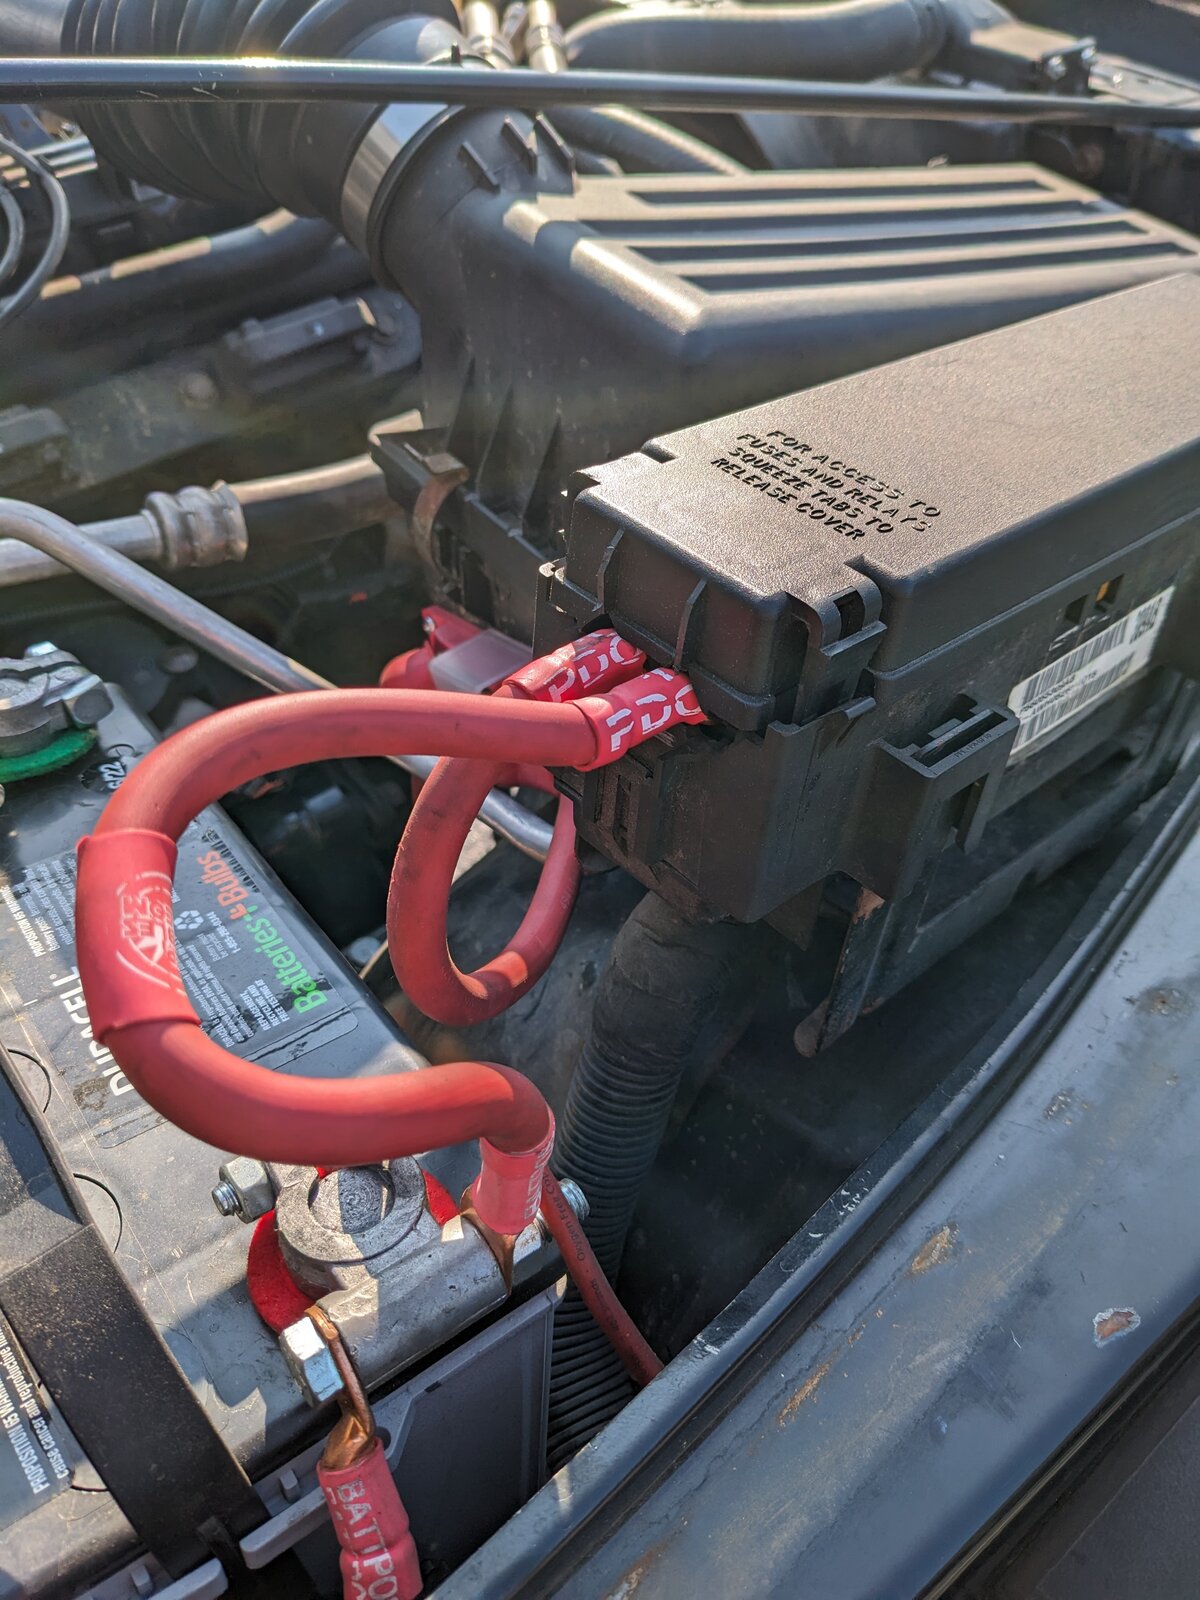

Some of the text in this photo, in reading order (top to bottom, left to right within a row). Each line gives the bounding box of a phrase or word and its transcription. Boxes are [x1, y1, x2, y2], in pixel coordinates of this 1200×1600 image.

[728, 447, 894, 533] SQUEEZE TABS TO
[737, 433, 932, 532] FUSES AND RELAYS
[767, 430, 940, 517] FOR ACCESS TO
[711, 458, 865, 540] RELEASE COVER
[17, 918, 46, 957] PROPOSITION
[246, 983, 281, 1027] RECYCLING AND
[254, 977, 290, 1022] FREE TESTING AT
[1, 1346, 33, 1401] reproductive
[3, 1412, 20, 1428] 65
[20, 1398, 41, 1418] and
[7, 1424, 50, 1495] PROPOSITION
[32, 1417, 56, 1457] cancer
[50, 1453, 70, 1479] cause
